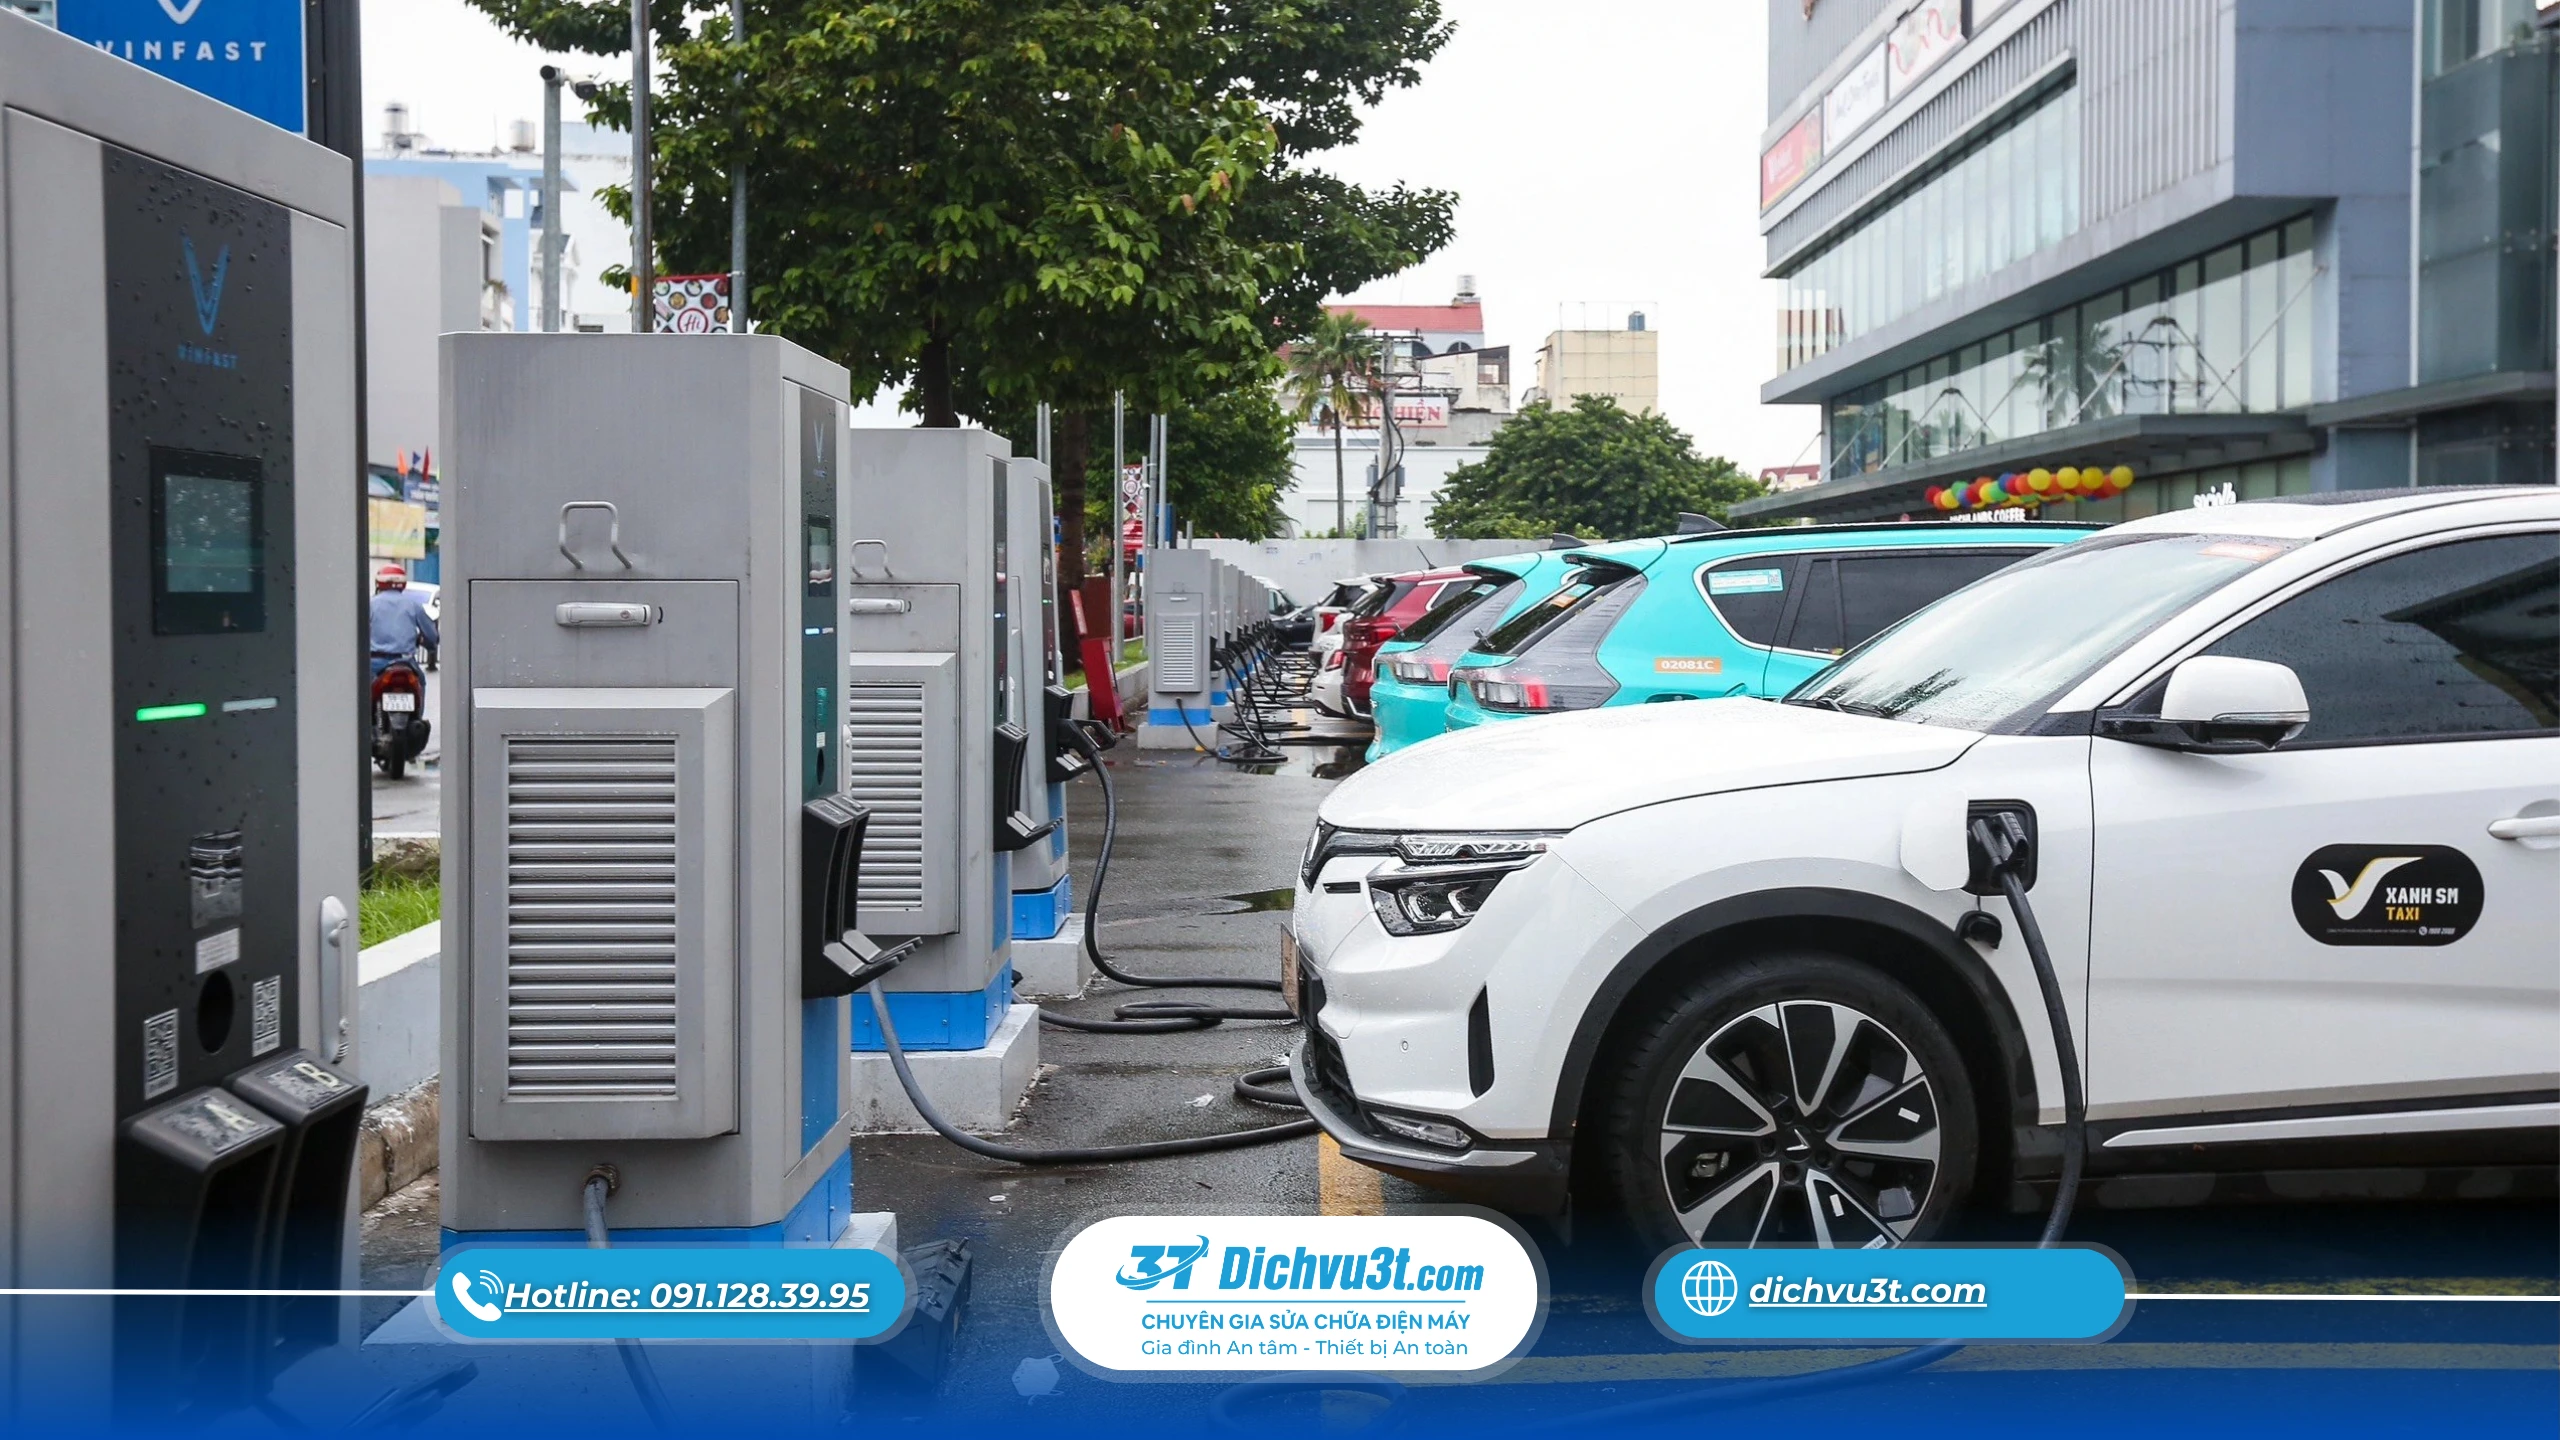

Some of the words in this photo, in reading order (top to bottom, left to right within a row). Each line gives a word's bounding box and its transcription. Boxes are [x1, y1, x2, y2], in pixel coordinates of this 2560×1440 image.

[95, 40, 267, 61] VINFAST
[1661, 660, 1714, 670] 02081C
[2385, 887, 2432, 904] XANH
[2435, 887, 2459, 904] SM
[2386, 906, 2420, 921] TAXI
[293, 1062, 342, 1092] B
